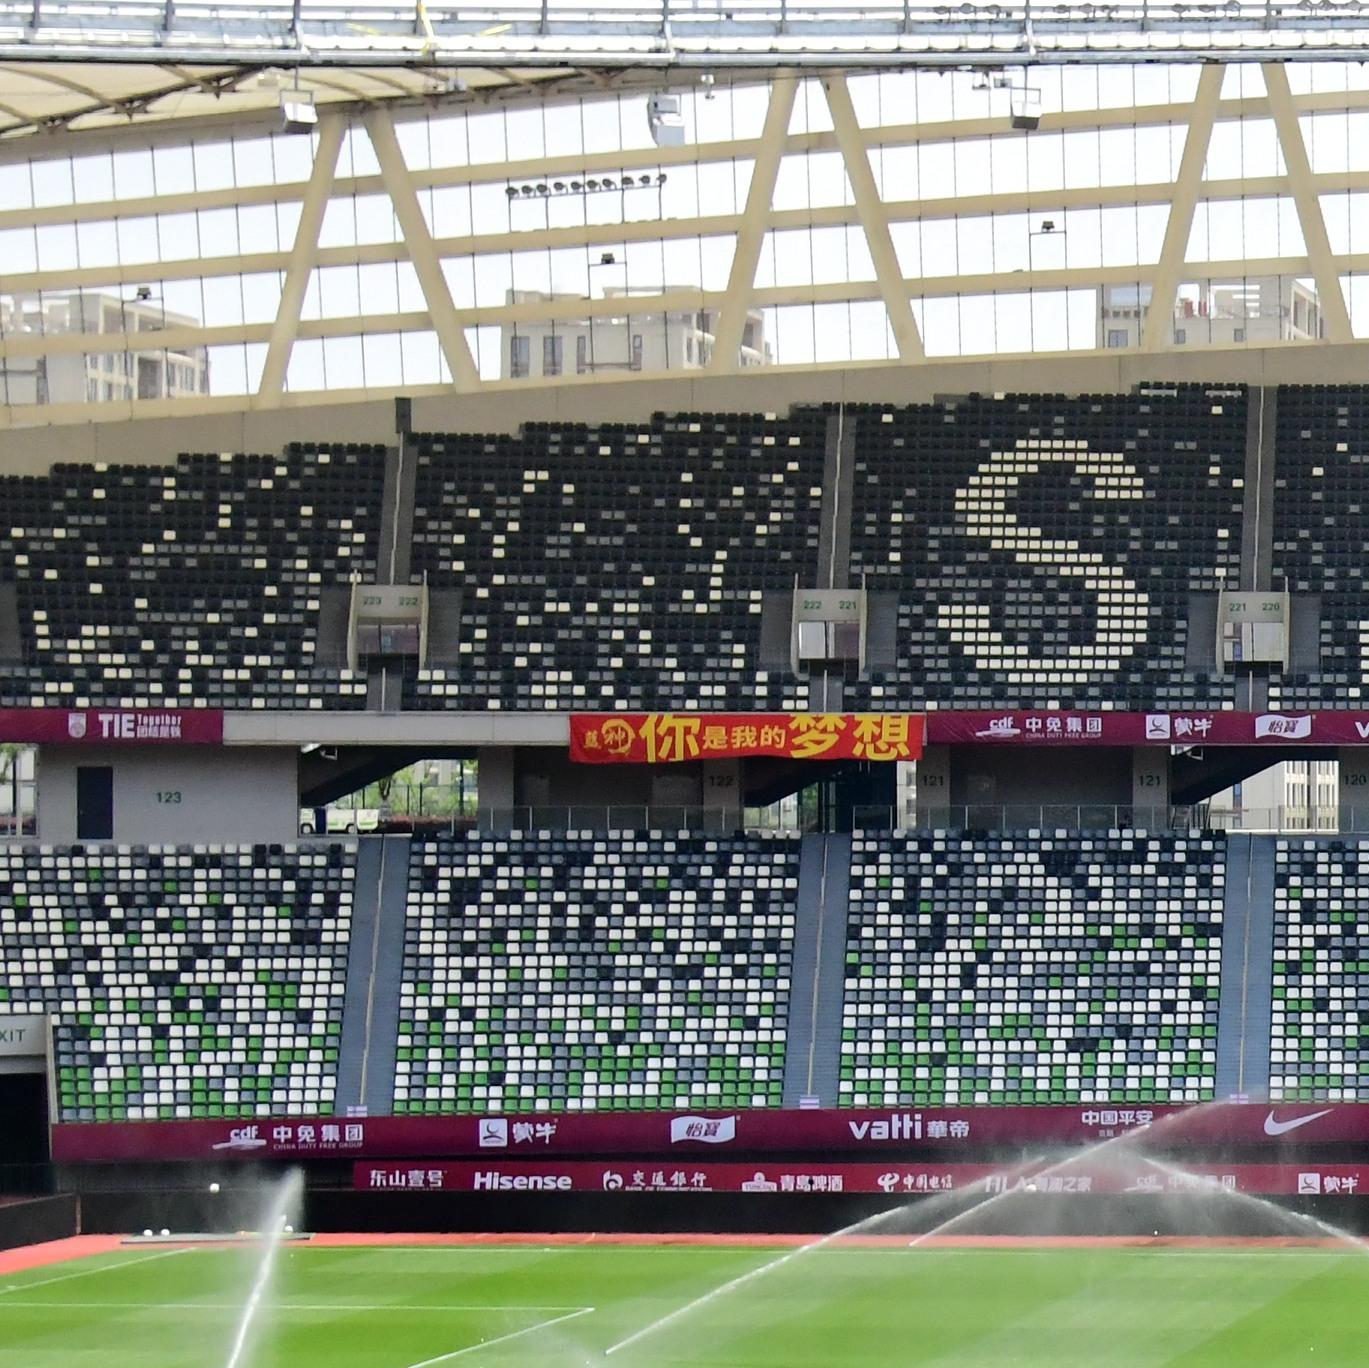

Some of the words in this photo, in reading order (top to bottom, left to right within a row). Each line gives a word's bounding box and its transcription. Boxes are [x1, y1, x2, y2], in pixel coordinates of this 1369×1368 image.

[803, 600, 822, 610] 222
[839, 600, 857, 610] 221
[1229, 602, 1246, 612] 221
[98, 713, 136, 738] TIE
[989, 716, 1014, 730] cdf
[1025, 716, 1102, 732] 中免集团
[1174, 717, 1211, 738] 蒙牛
[639, 714, 910, 763] 你是我的梦想
[709, 774, 733, 787] 122
[922, 774, 944, 787] 121
[1138, 774, 1161, 786] 121
[1344, 774, 1367, 787] 120
[156, 791, 182, 804] 123
[1081, 1109, 1153, 1125] 中国平安
[230, 1124, 259, 1140] cdf
[273, 1123, 364, 1143] 中免集团
[512, 1121, 557, 1144] 蒙牛
[848, 1113, 921, 1140] vatti
[370, 1169, 443, 1187] 东山壹号
[473, 1171, 571, 1190] Hisense
[632, 1170, 707, 1187] 交通银行
[903, 1172, 953, 1190] 中国电信
